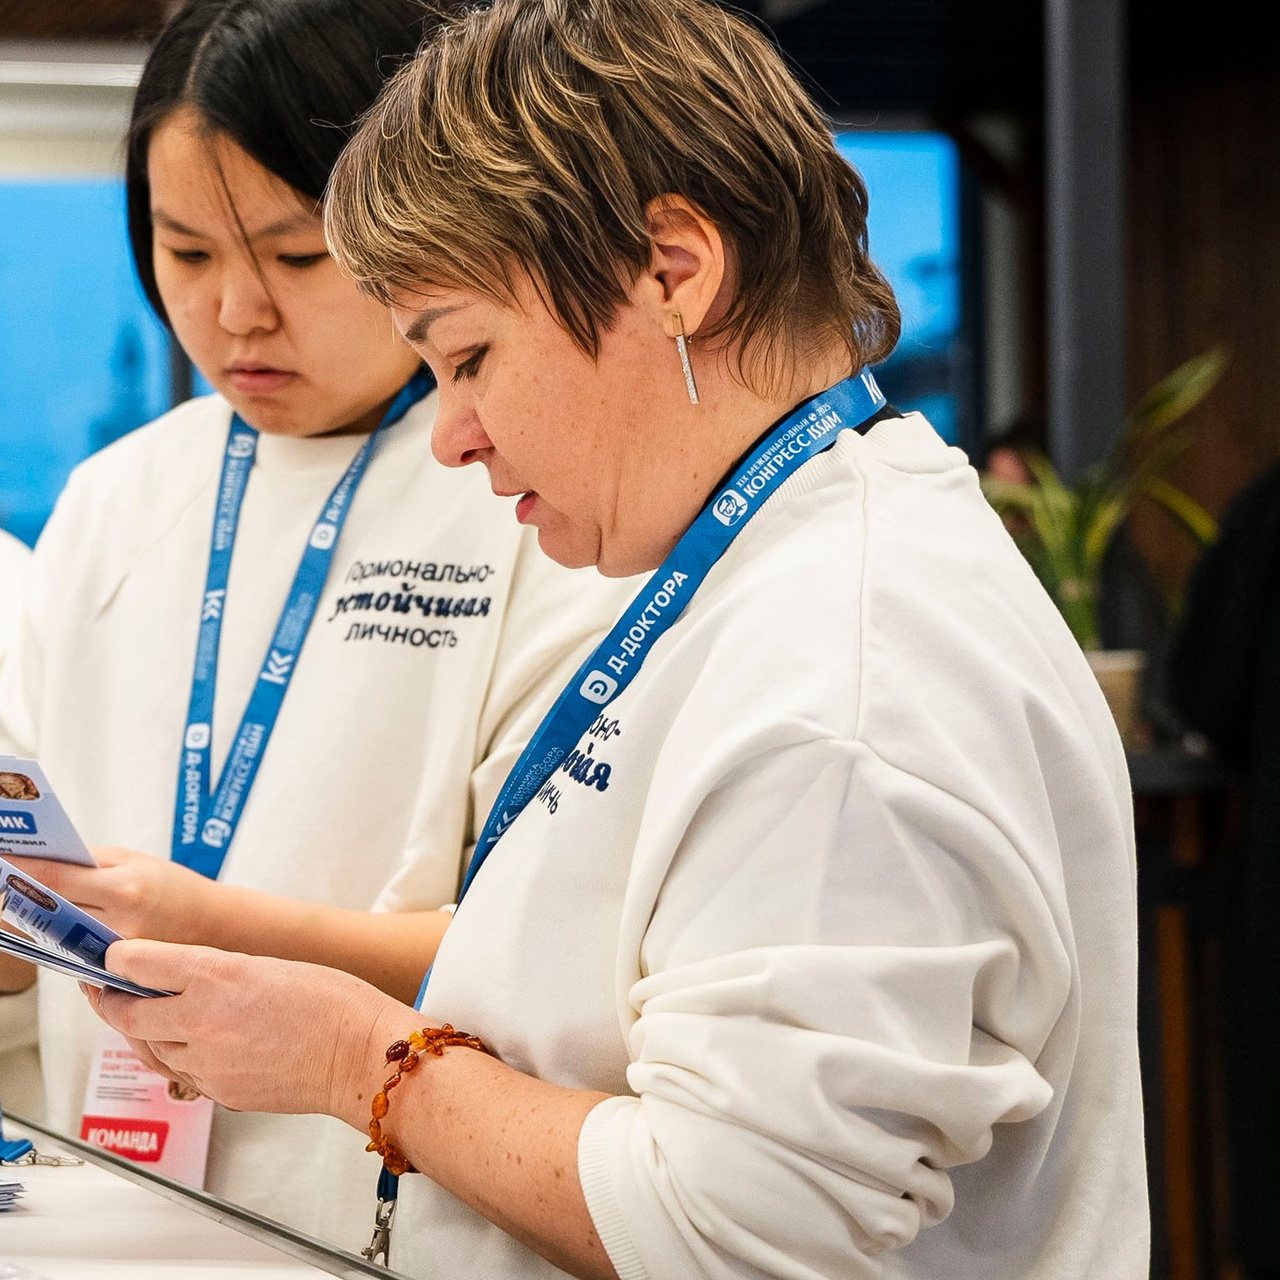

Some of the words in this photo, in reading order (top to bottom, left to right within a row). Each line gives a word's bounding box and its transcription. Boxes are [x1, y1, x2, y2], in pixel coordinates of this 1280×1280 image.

[743, 433, 811, 499] КОНГРЕСС
[807, 410, 842, 440] ISSAM
[749, 418, 809, 476] МЕЖДУНАРОДНЫЙ
[607, 570, 688, 675] Д-ДОКТОРА
[509, 763, 540, 806] КЛИНИКА
[87, 1127, 158, 1152] КОМАНДА
